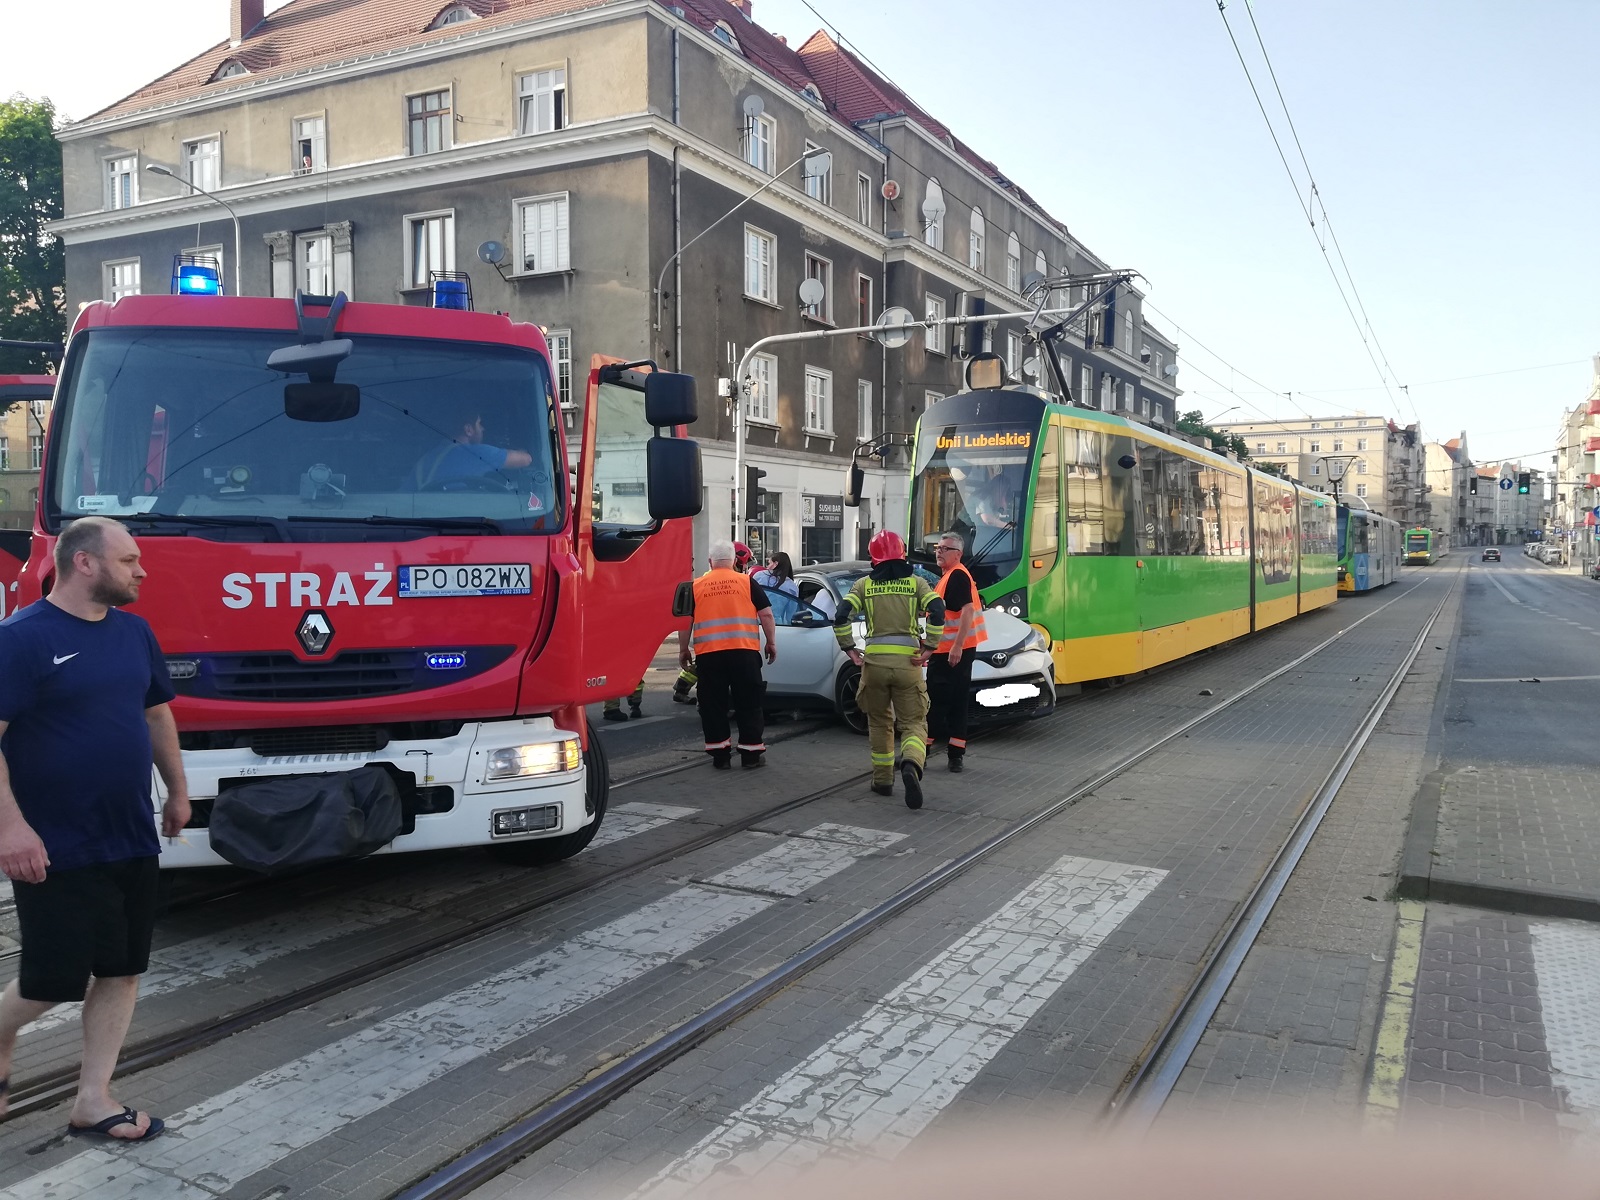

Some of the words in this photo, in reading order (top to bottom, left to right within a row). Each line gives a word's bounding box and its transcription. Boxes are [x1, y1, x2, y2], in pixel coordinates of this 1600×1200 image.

[936, 435, 961, 448] Unii
[964, 432, 1031, 448] Lubelskiej
[818, 503, 832, 512] SUSHI
[832, 504, 842, 513] BAR
[222, 562, 393, 609] STRAŻ
[414, 568, 448, 590] PO
[456, 567, 526, 589] 082WX
[703, 589, 740, 599] RATOWNICZA
